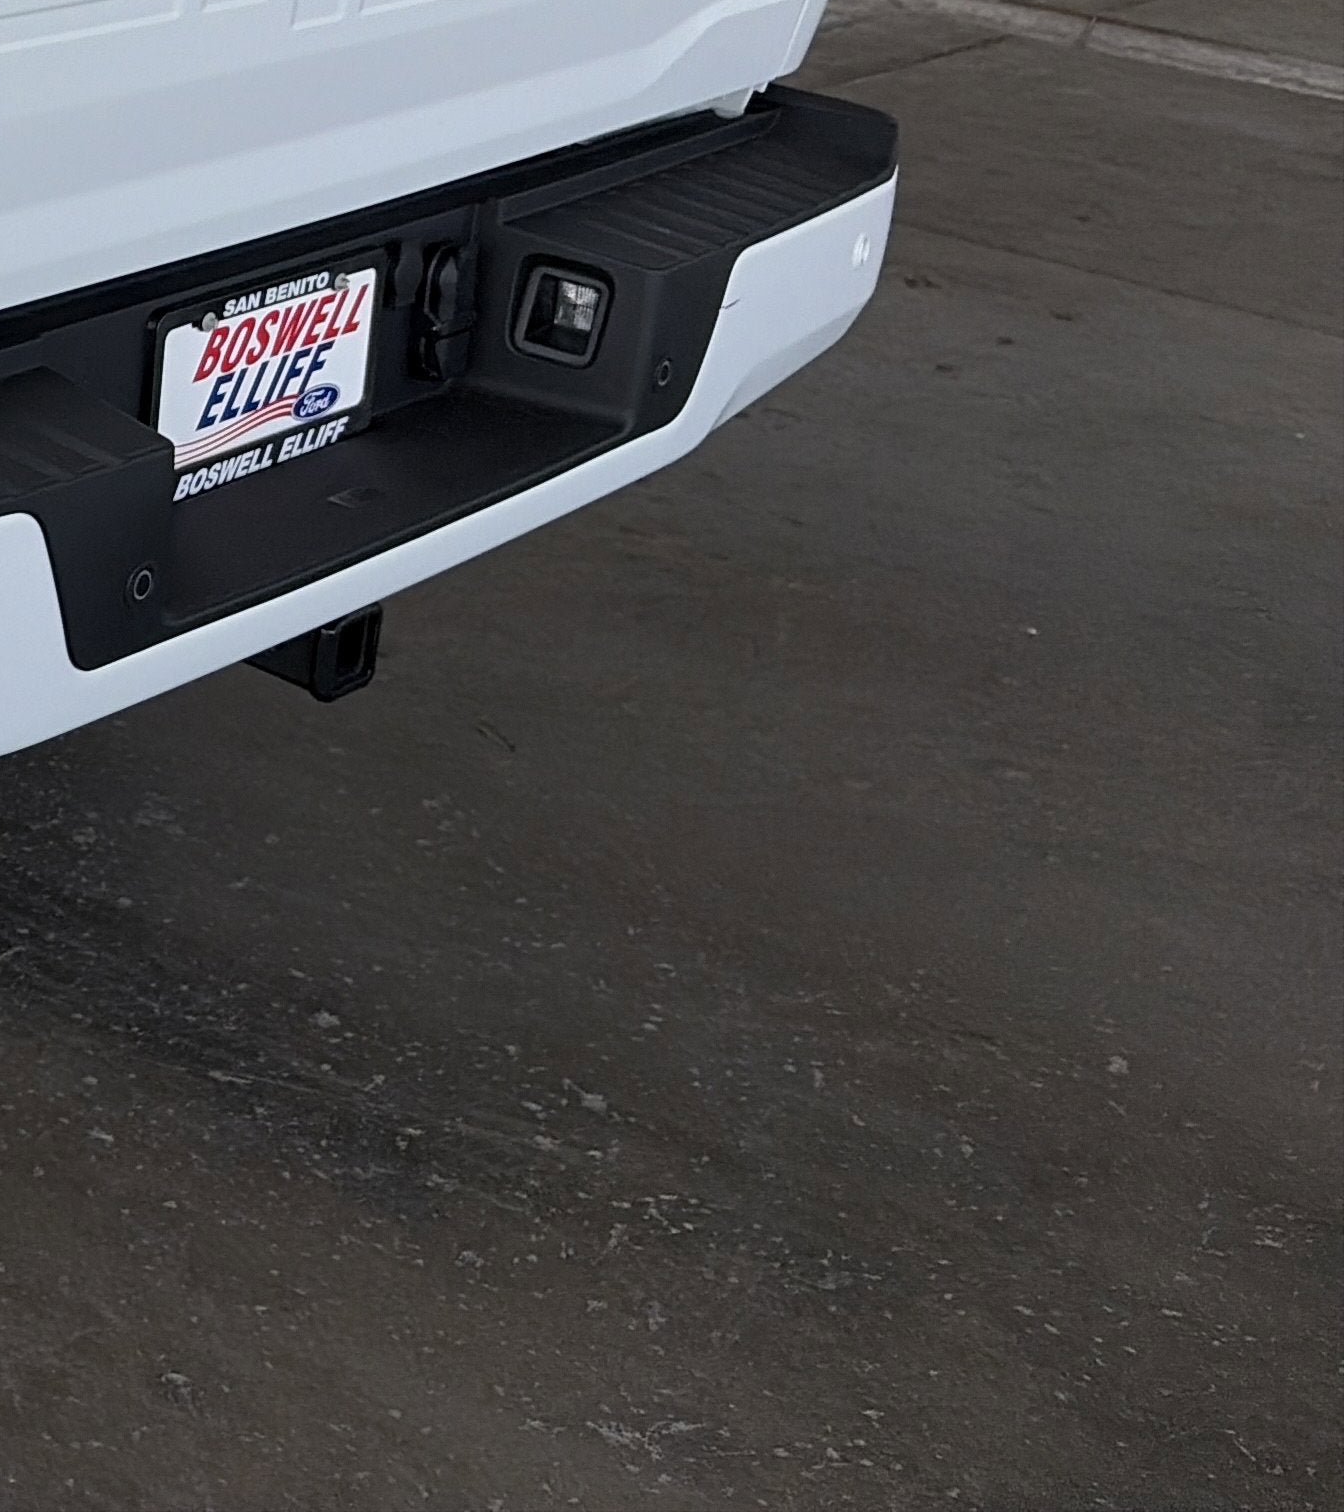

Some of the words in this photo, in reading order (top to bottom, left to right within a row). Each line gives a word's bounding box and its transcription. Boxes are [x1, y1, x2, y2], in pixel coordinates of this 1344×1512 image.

[192, 283, 370, 384] BOSWELL
[222, 290, 262, 318] SAN
[264, 271, 330, 305] BENITO
[195, 340, 336, 432] ELLIFF
[299, 389, 331, 418] Ford
[172, 443, 273, 502] BOSWELL
[277, 416, 350, 463] ELLIFF
